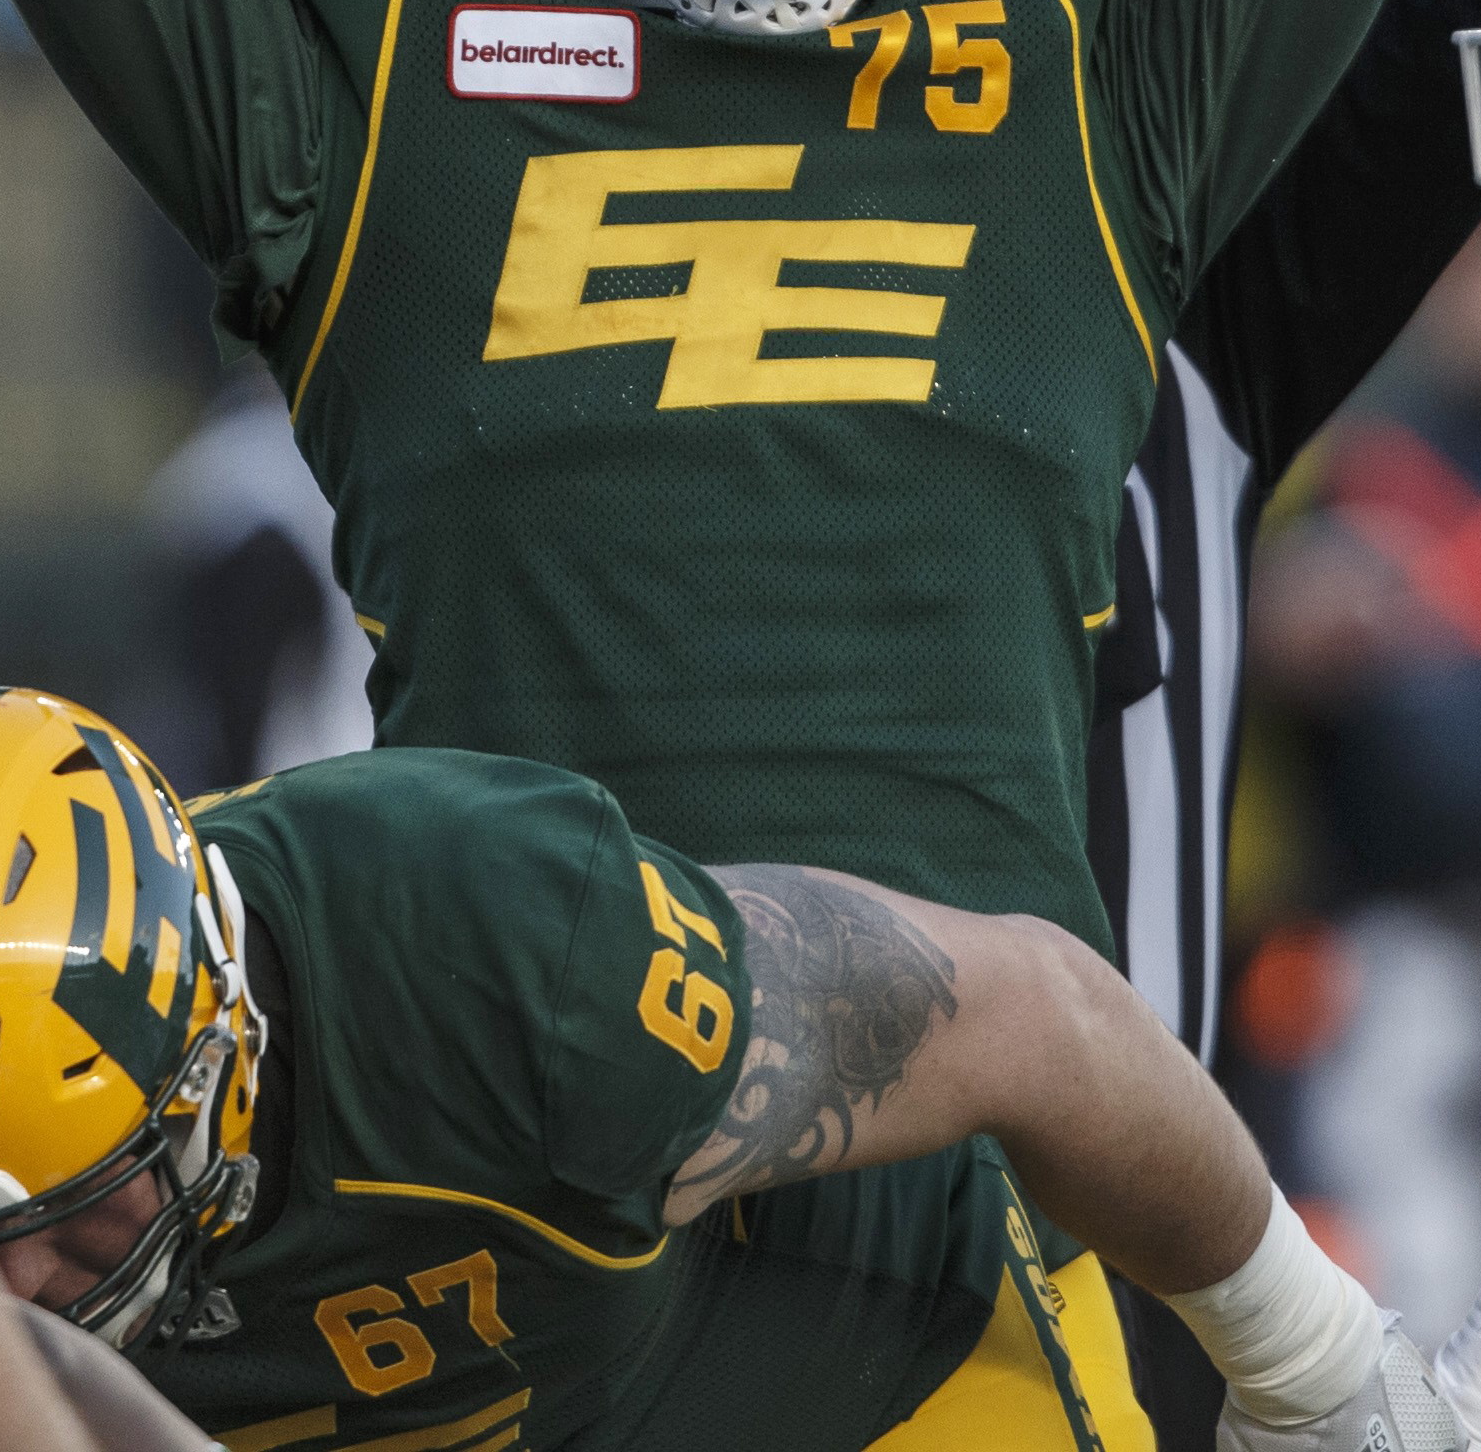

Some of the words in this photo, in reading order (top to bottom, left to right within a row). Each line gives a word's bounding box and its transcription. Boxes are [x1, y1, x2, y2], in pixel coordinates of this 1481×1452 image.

[460, 38, 625, 69] belairdirect.
[828, 0, 1012, 133] 75
[482, 144, 976, 410] EE
[637, 861, 734, 1074] 67
[313, 1248, 516, 1396] 67
